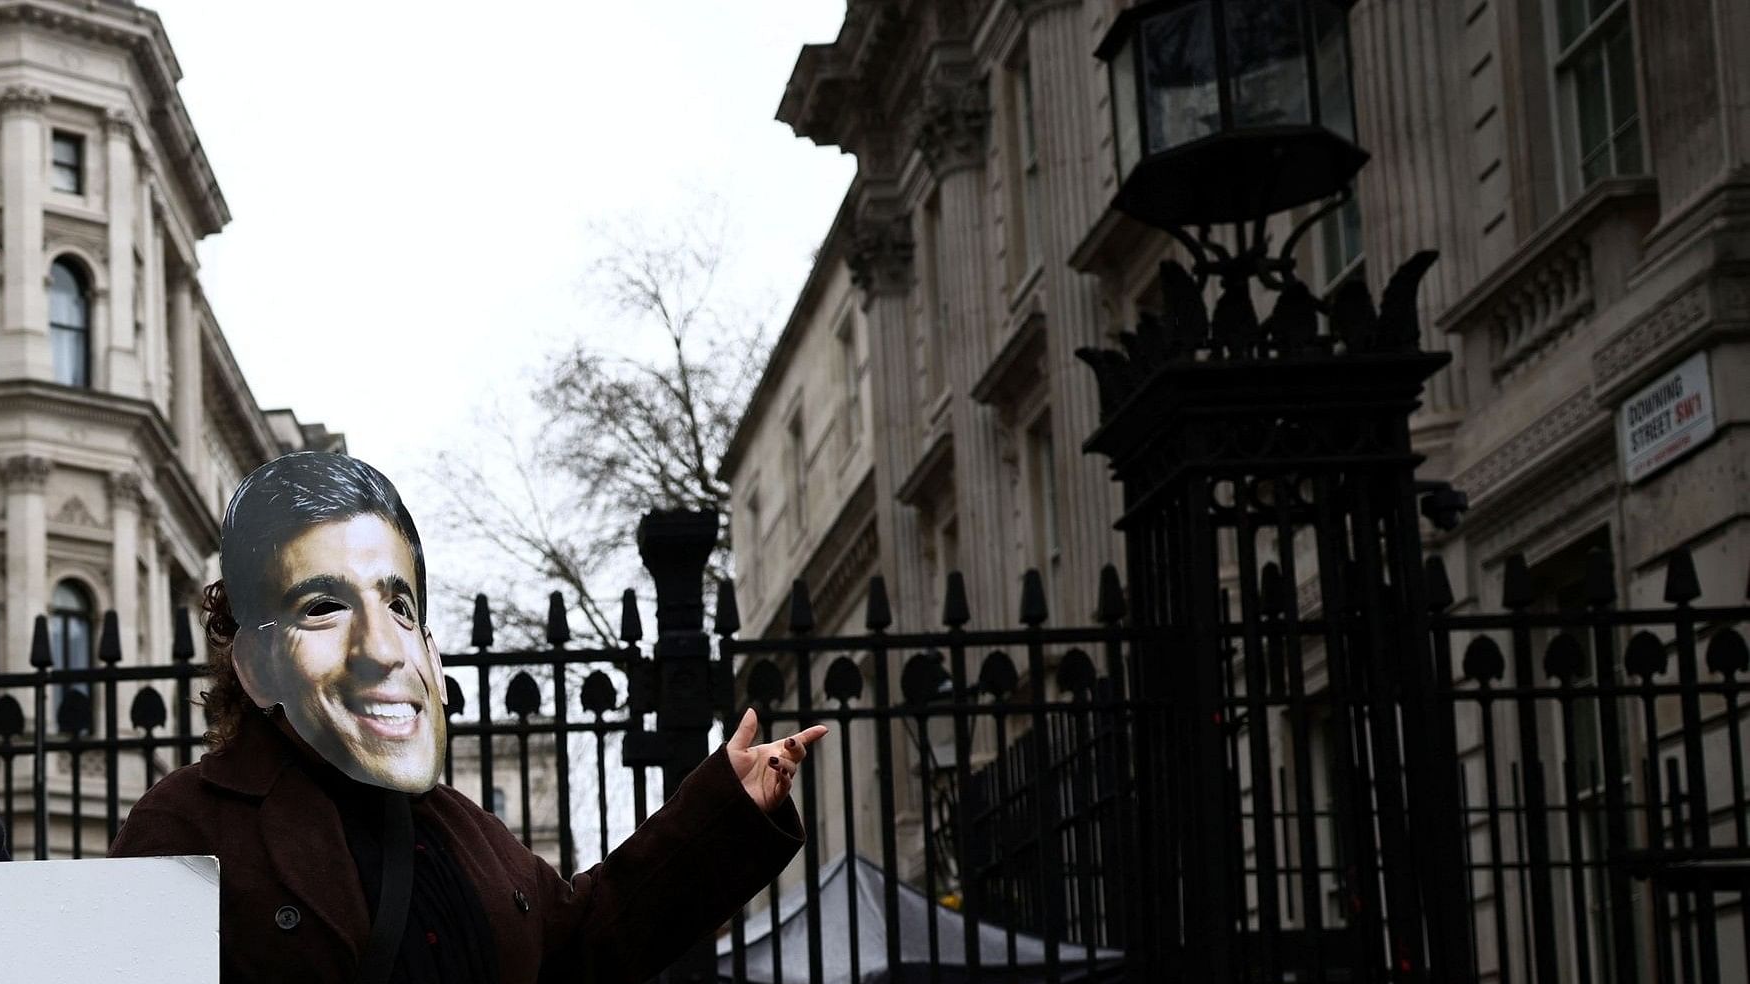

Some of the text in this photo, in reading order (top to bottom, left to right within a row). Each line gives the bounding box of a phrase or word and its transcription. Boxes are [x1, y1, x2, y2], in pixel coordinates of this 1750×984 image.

[1628, 374, 1684, 427] DOWNING
[1631, 392, 1702, 452] STREET SW1
